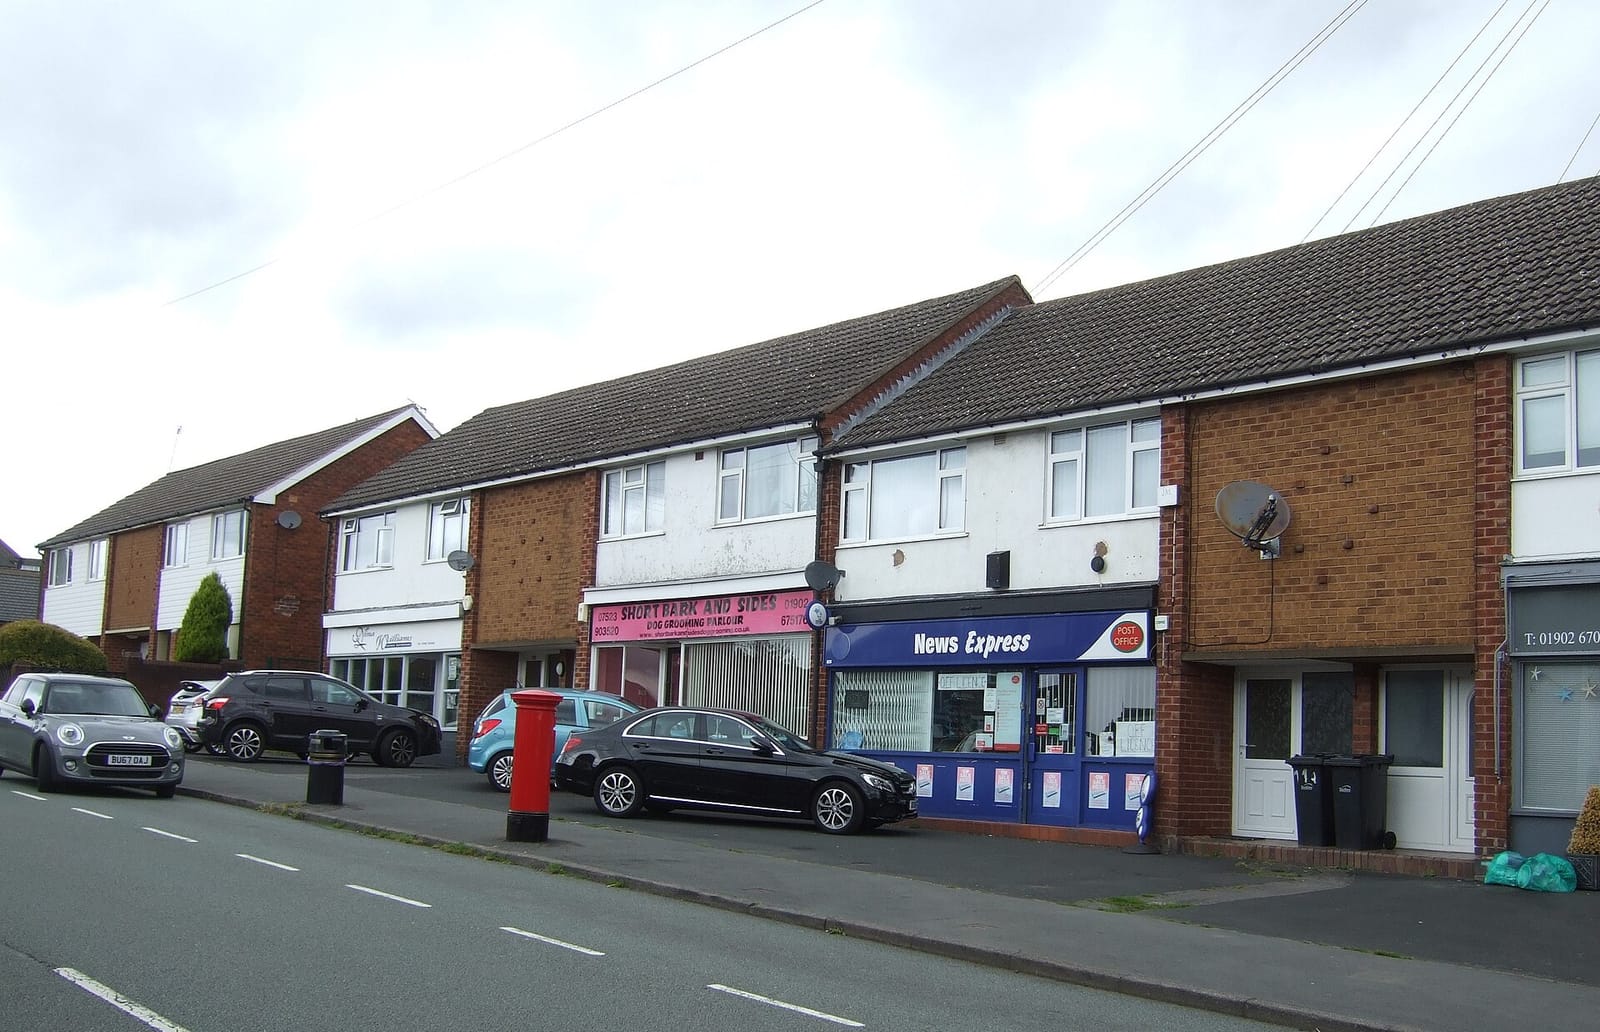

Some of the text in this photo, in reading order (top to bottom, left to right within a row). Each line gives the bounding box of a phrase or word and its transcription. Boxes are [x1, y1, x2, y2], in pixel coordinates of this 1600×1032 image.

[621, 595, 777, 620] SHORT BARK AND SIDES
[784, 598, 808, 609] 01902
[647, 615, 744, 630] DOG GROOMING PARLOUR
[1117, 626, 1136, 635] POST
[914, 630, 1031, 659] News Express
[1113, 636, 1139, 646] OFFICE
[1524, 633, 1536, 645] T:
[1539, 632, 1575, 645] 01902
[111, 755, 132, 764] BU67
